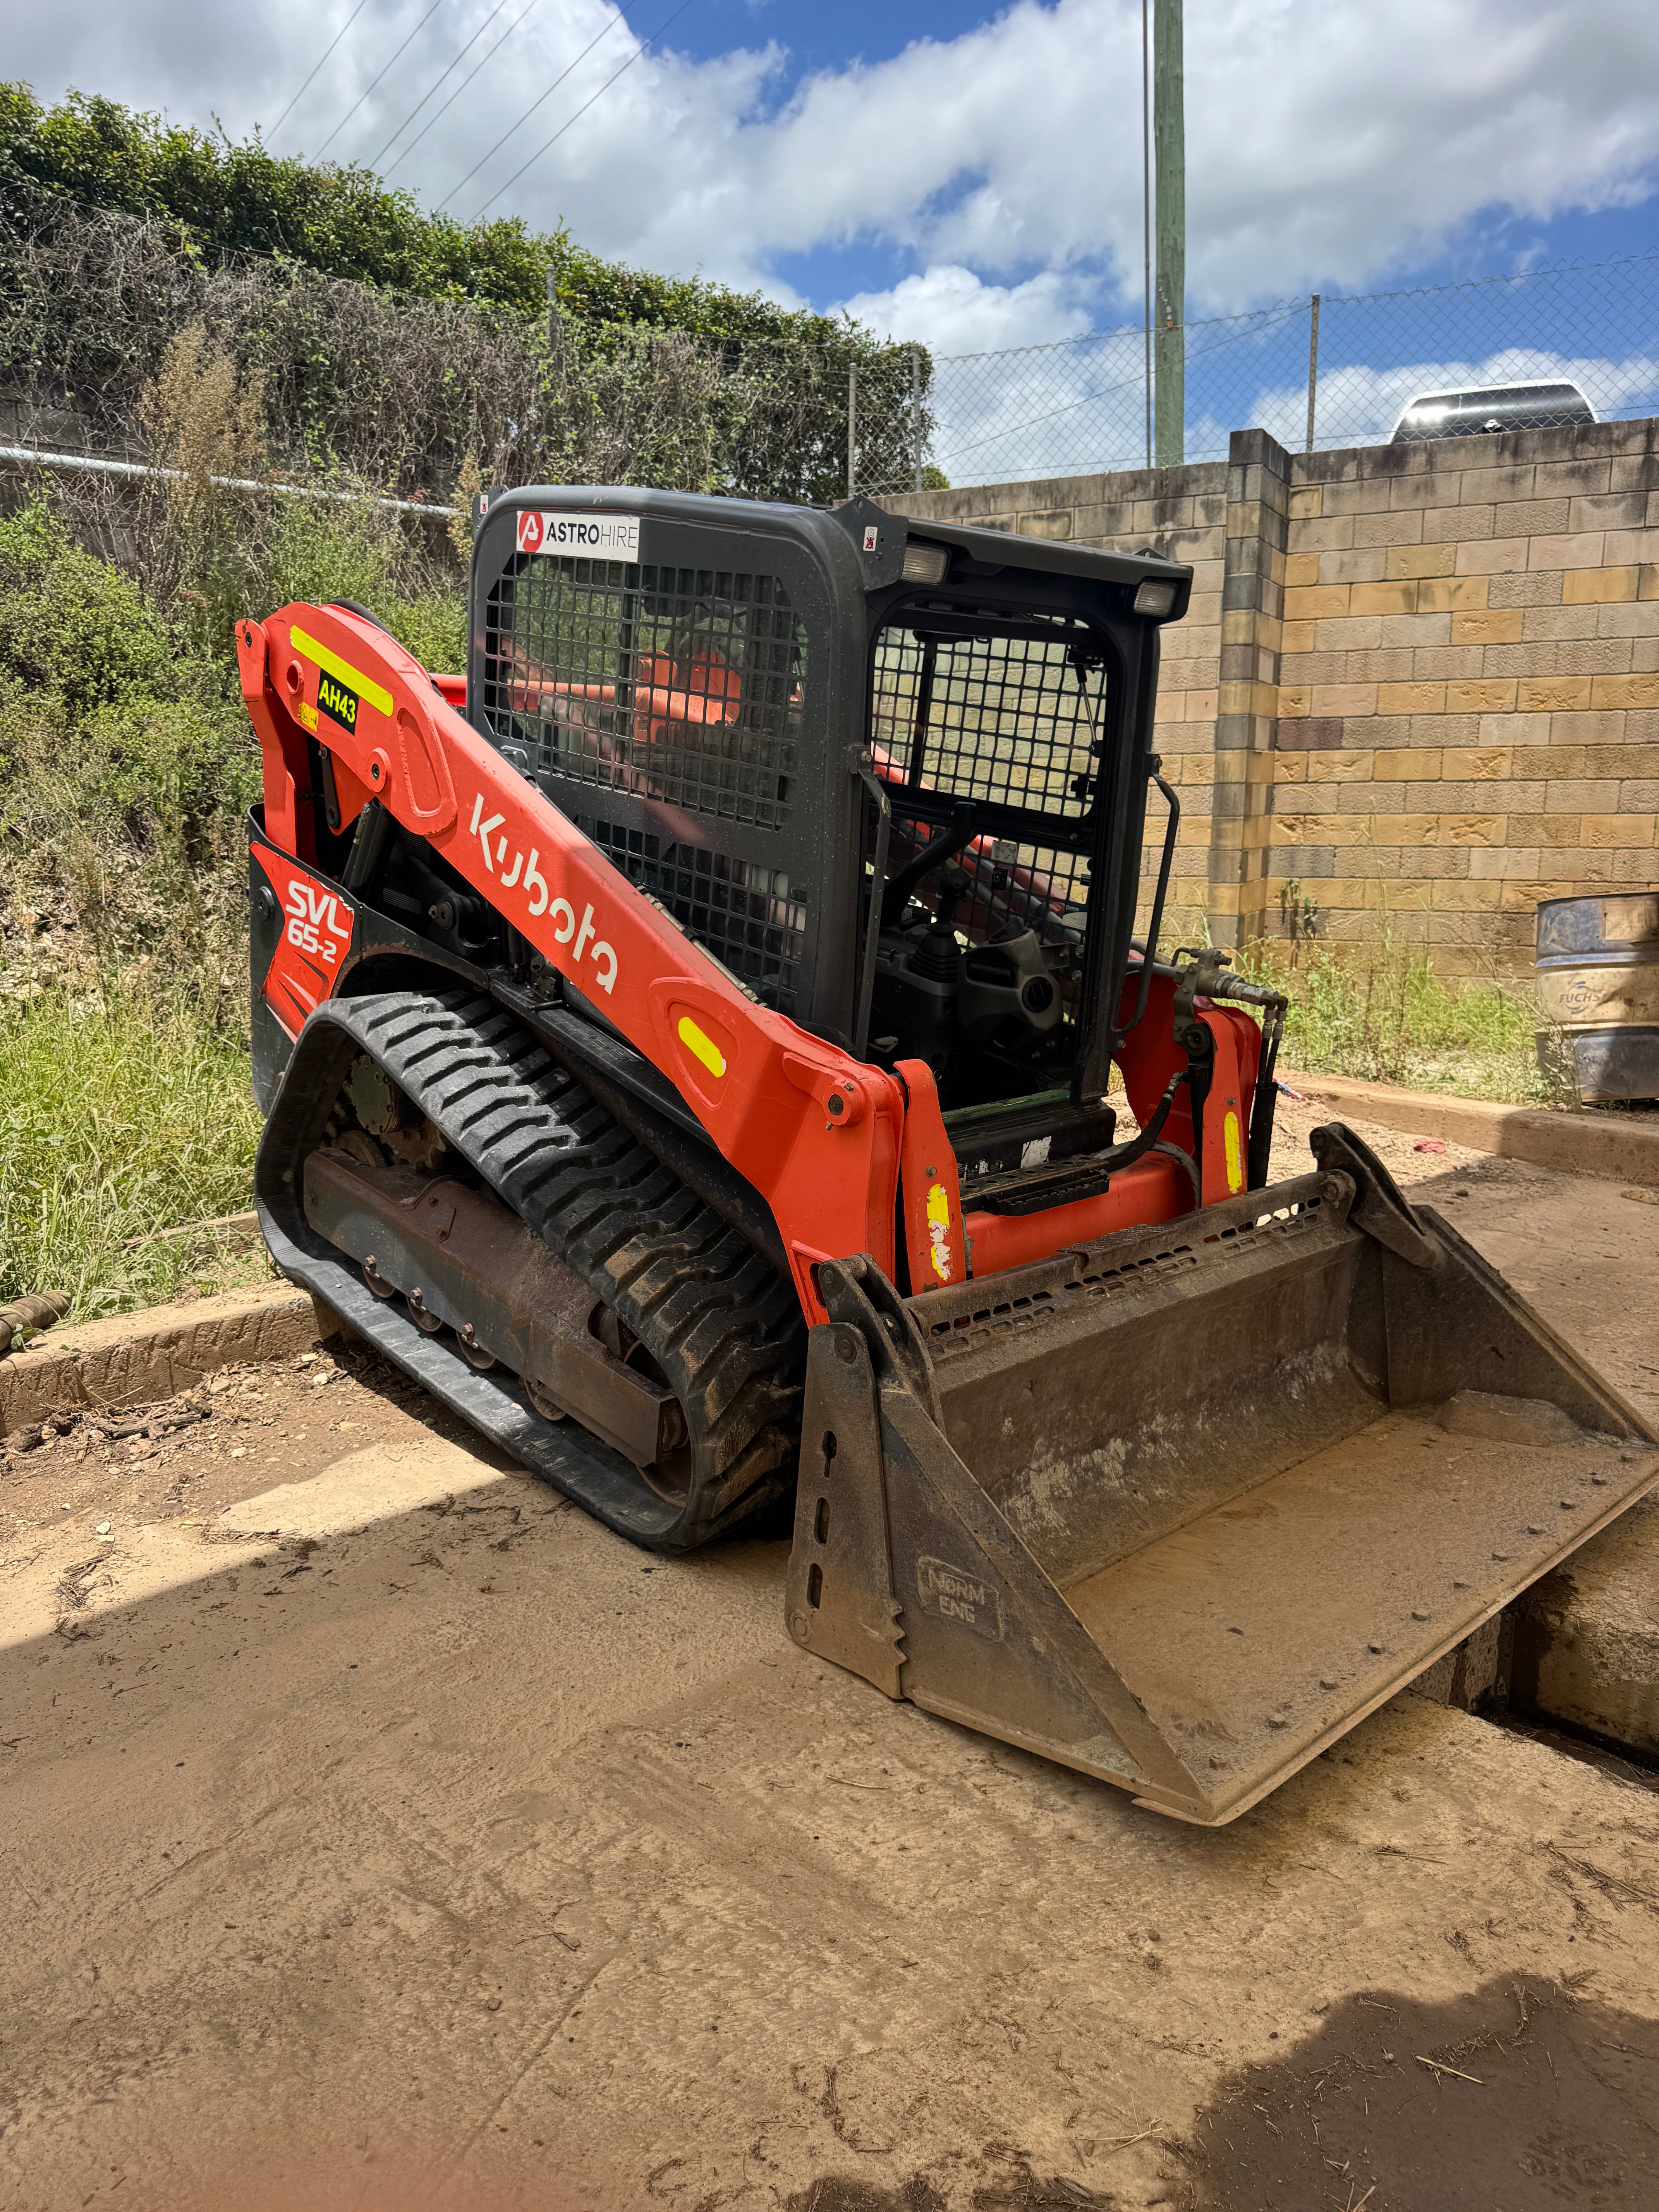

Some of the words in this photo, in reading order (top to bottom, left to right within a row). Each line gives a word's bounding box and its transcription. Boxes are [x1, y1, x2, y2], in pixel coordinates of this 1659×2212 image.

[546, 522, 638, 549] ASTROHIRE
[319, 679, 356, 723] AH43
[285, 880, 349, 939] SVL
[469, 792, 618, 995] Kubota
[287, 918, 337, 964] 65-2
[1559, 993, 1600, 1003] FUCHS
[939, 1595, 975, 1623] ENG
